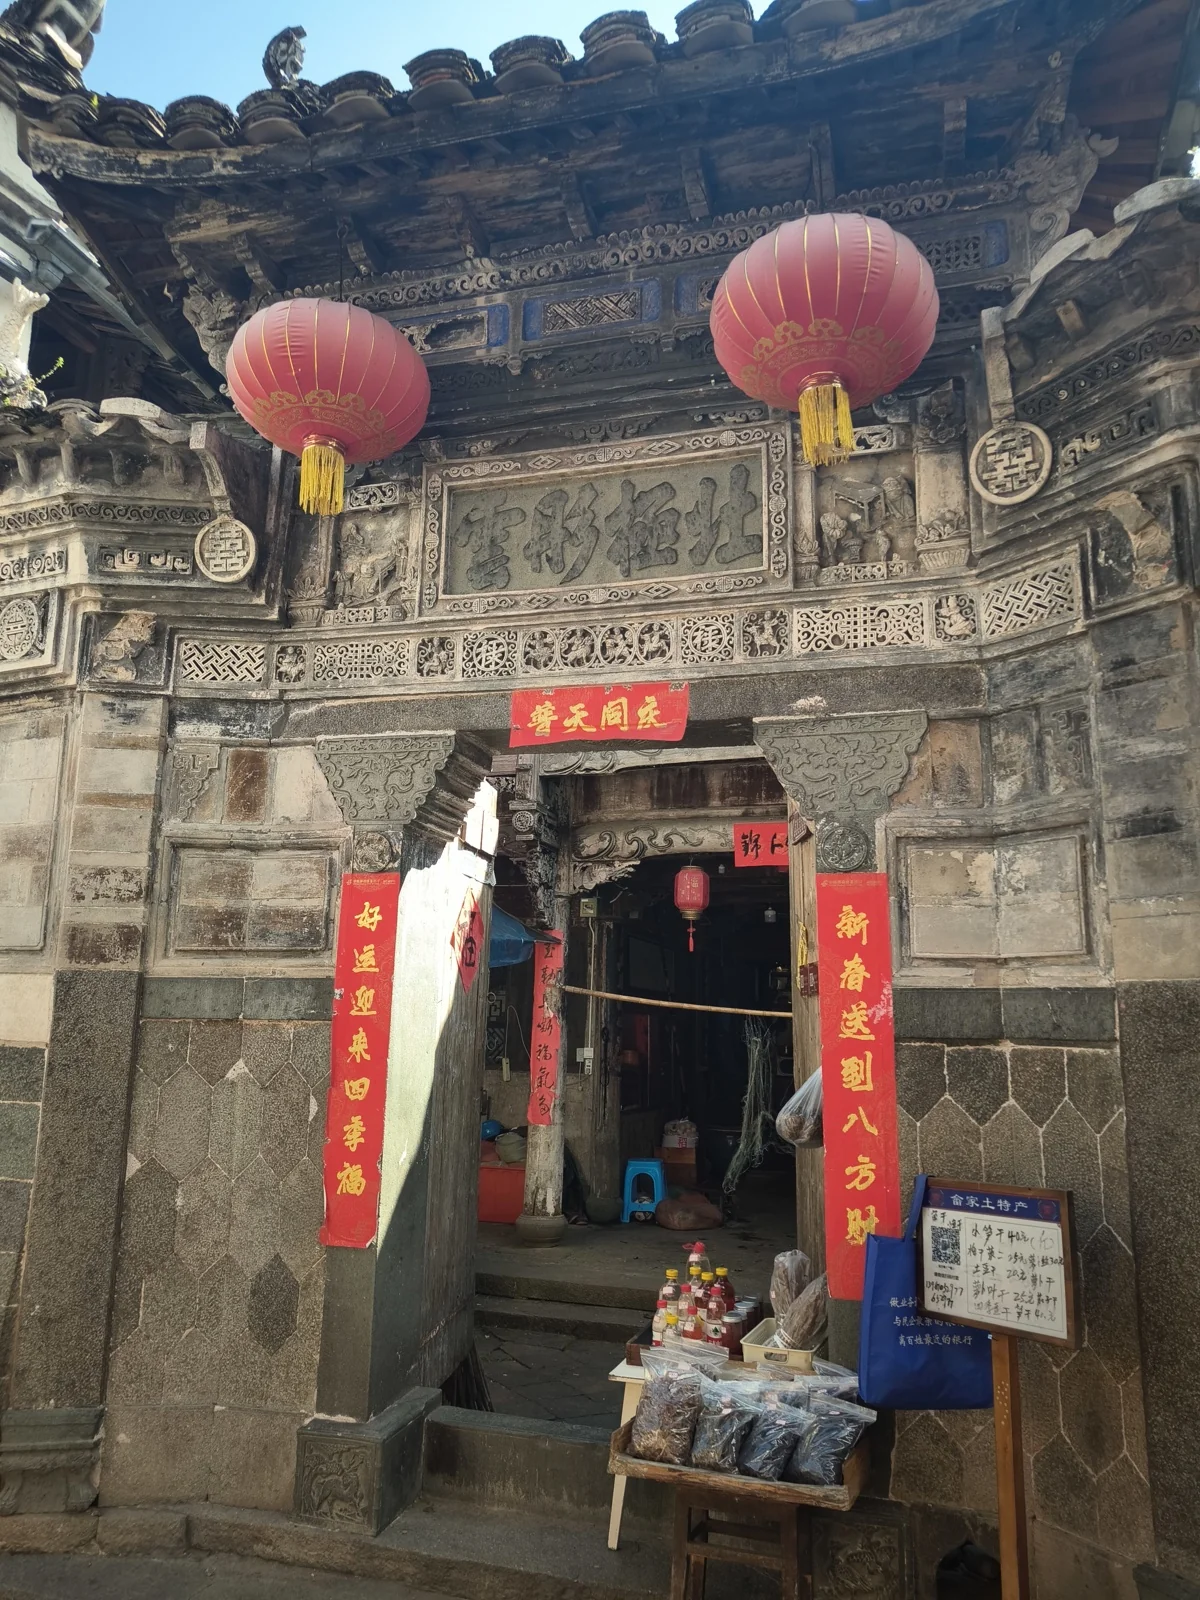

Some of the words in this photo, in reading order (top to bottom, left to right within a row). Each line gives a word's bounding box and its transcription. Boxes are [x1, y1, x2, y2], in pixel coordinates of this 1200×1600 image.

[336, 901, 383, 1197] 好运迎来四季福
[889, 1296, 919, 1308] 做业务
[898, 1333, 973, 1347] 离百姓最近的银行
